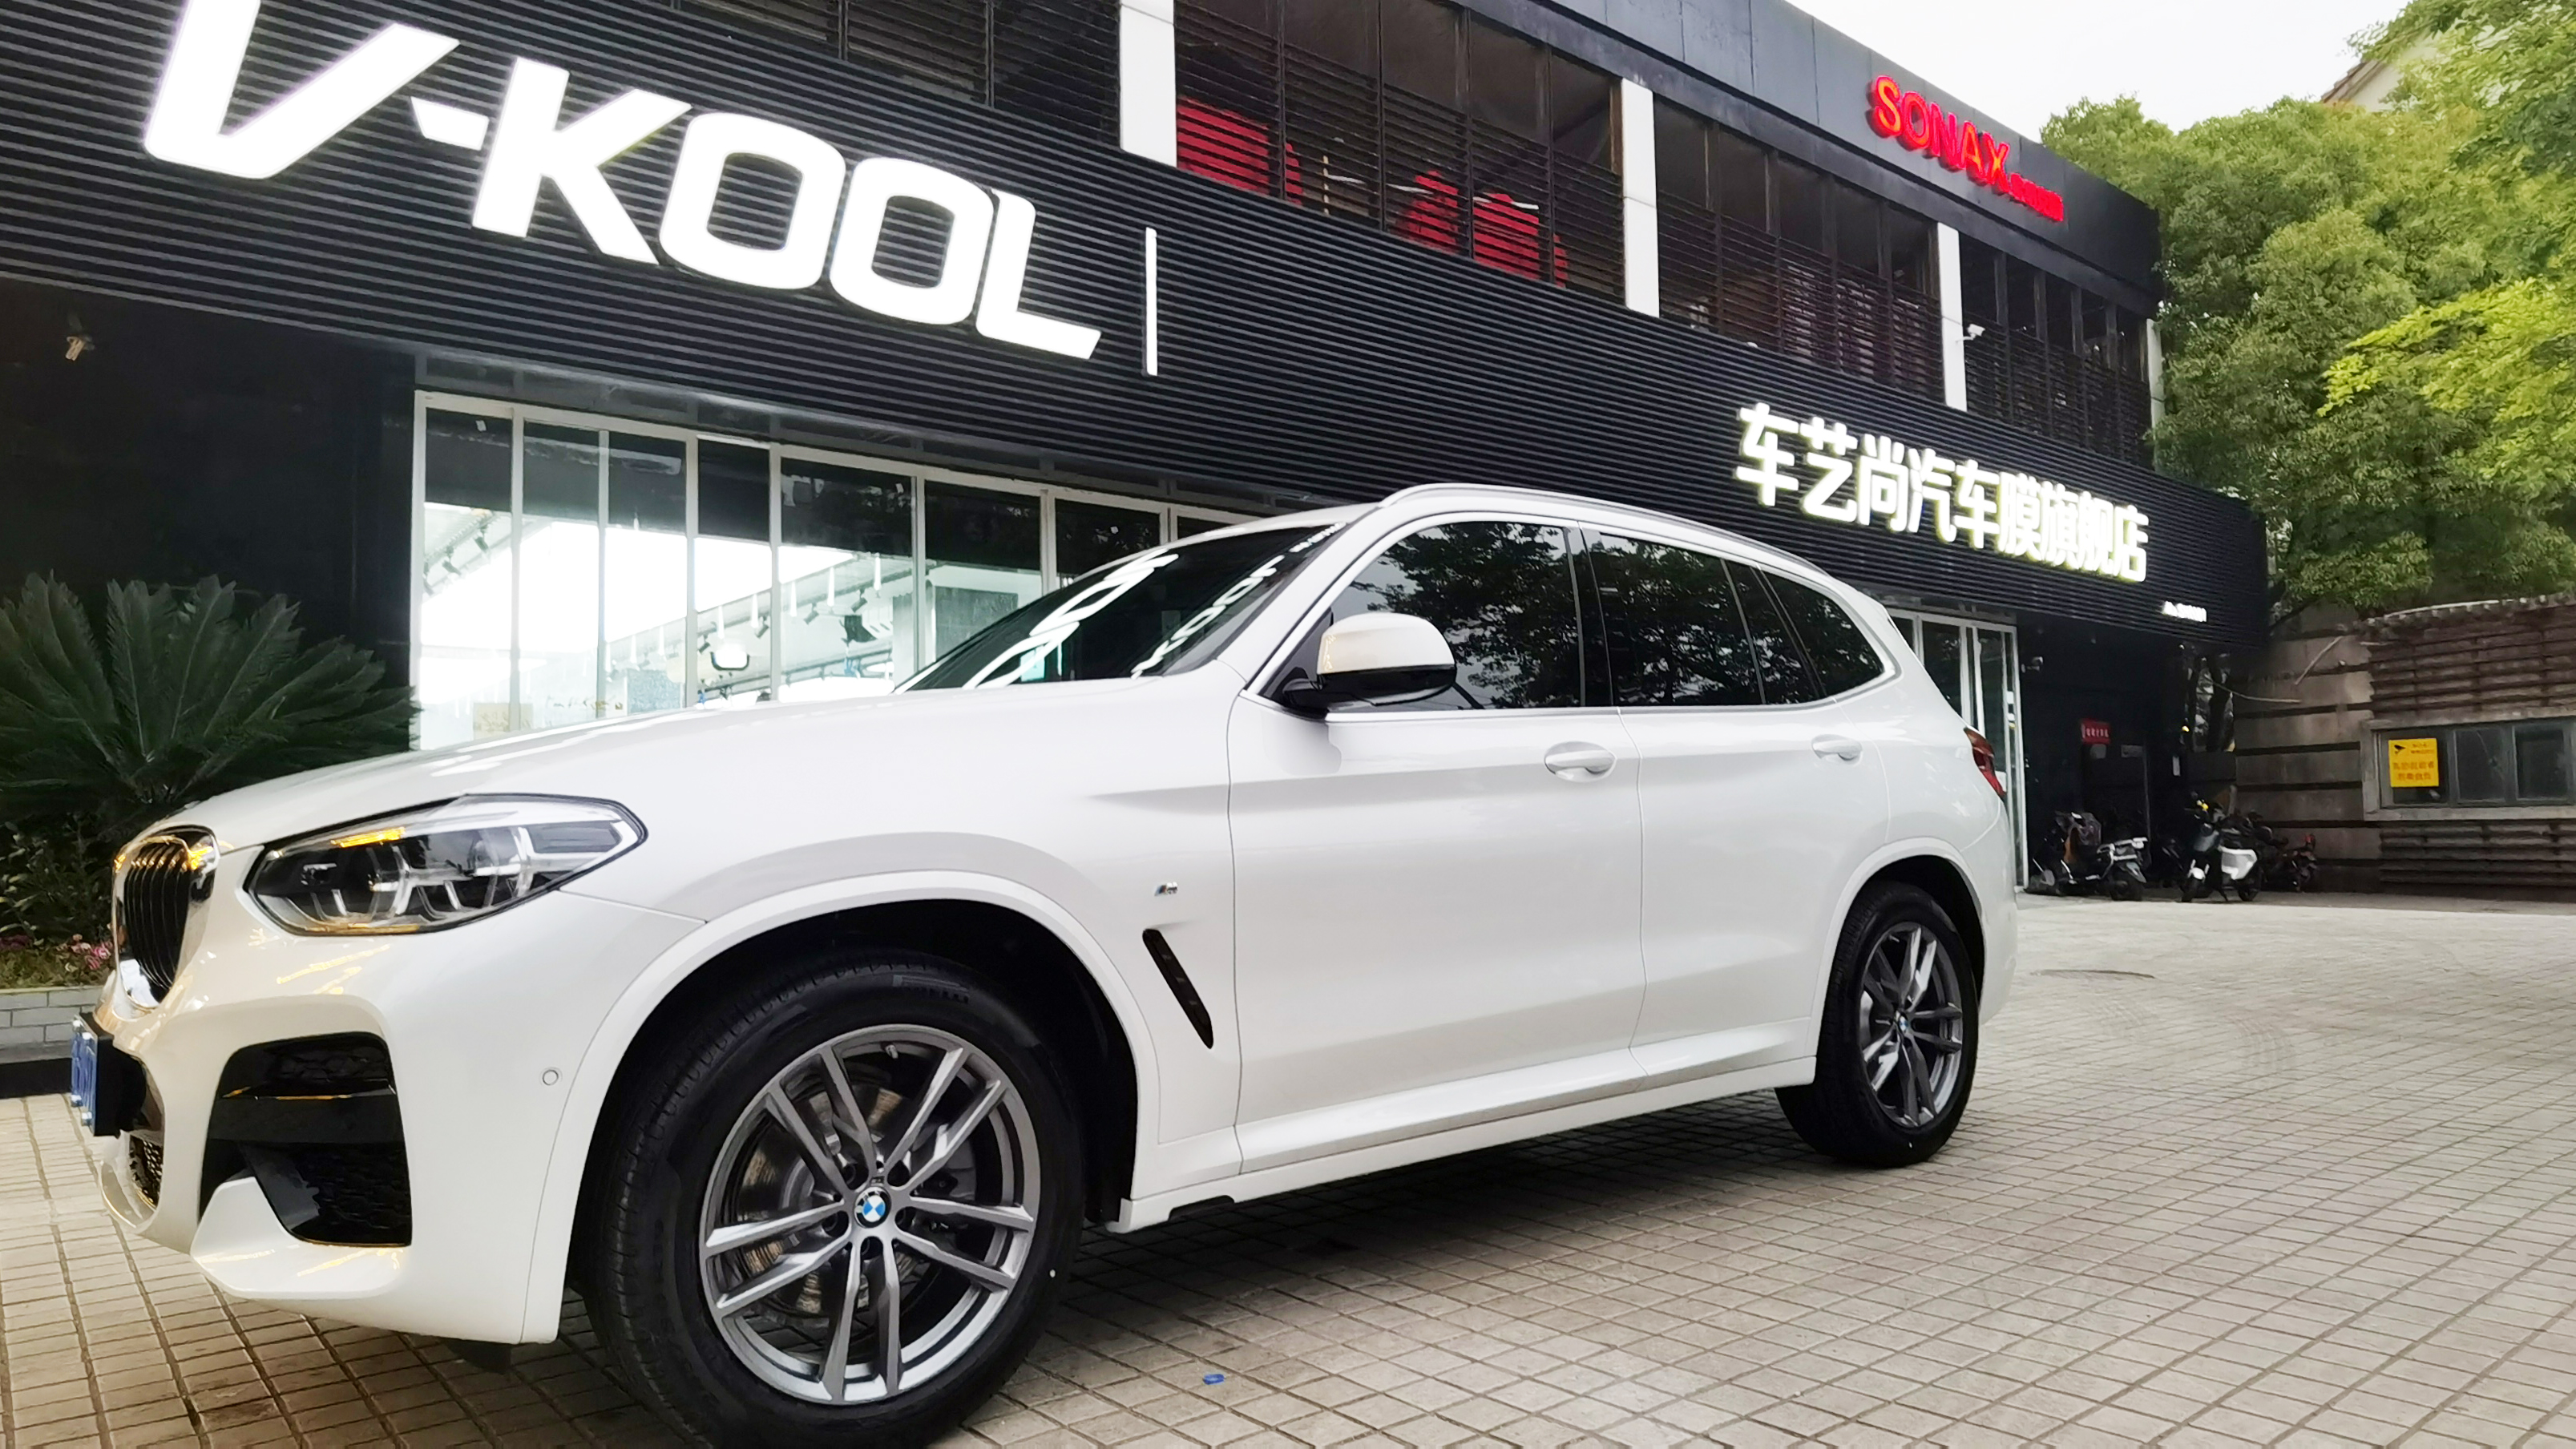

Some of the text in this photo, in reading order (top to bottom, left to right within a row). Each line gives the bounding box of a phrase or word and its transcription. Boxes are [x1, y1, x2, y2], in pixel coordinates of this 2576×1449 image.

[144, 0, 1102, 360] V-KOOL
[1869, 75, 2010, 195] SONAX
[1735, 402, 2150, 583] 车艺尚汽车膜旗舰店
